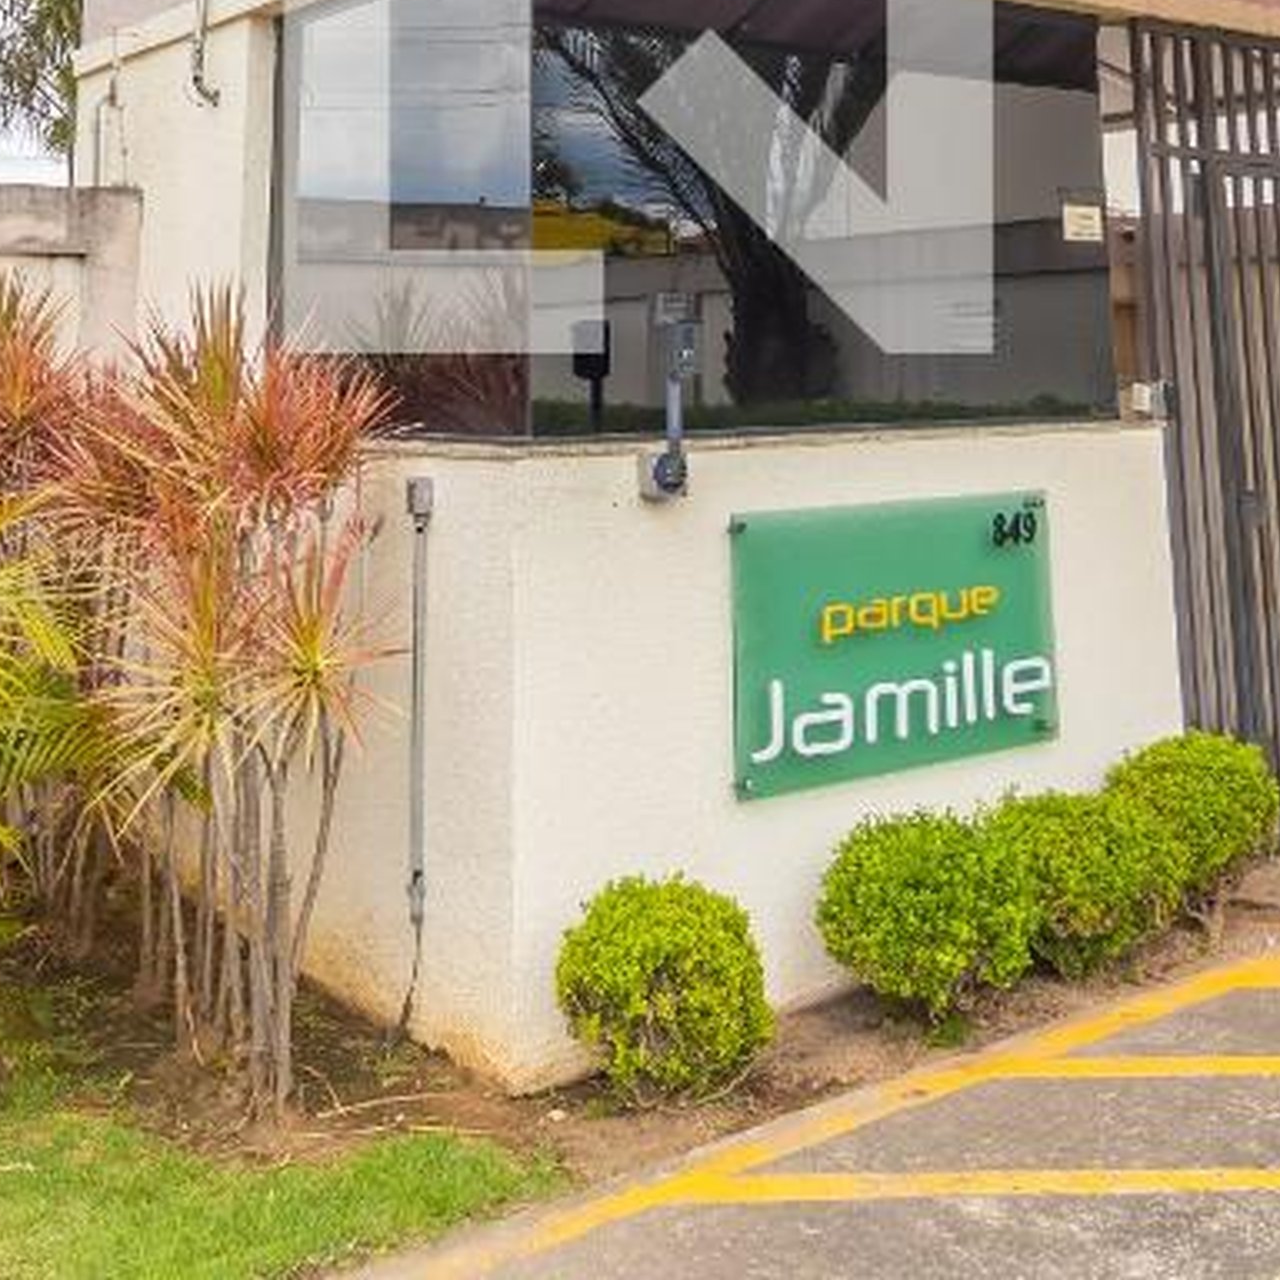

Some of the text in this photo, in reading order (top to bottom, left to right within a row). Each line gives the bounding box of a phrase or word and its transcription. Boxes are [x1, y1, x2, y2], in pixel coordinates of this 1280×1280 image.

[991, 512, 1037, 547] 849
[821, 585, 1000, 644] parque
[750, 648, 1052, 764] Jamille
